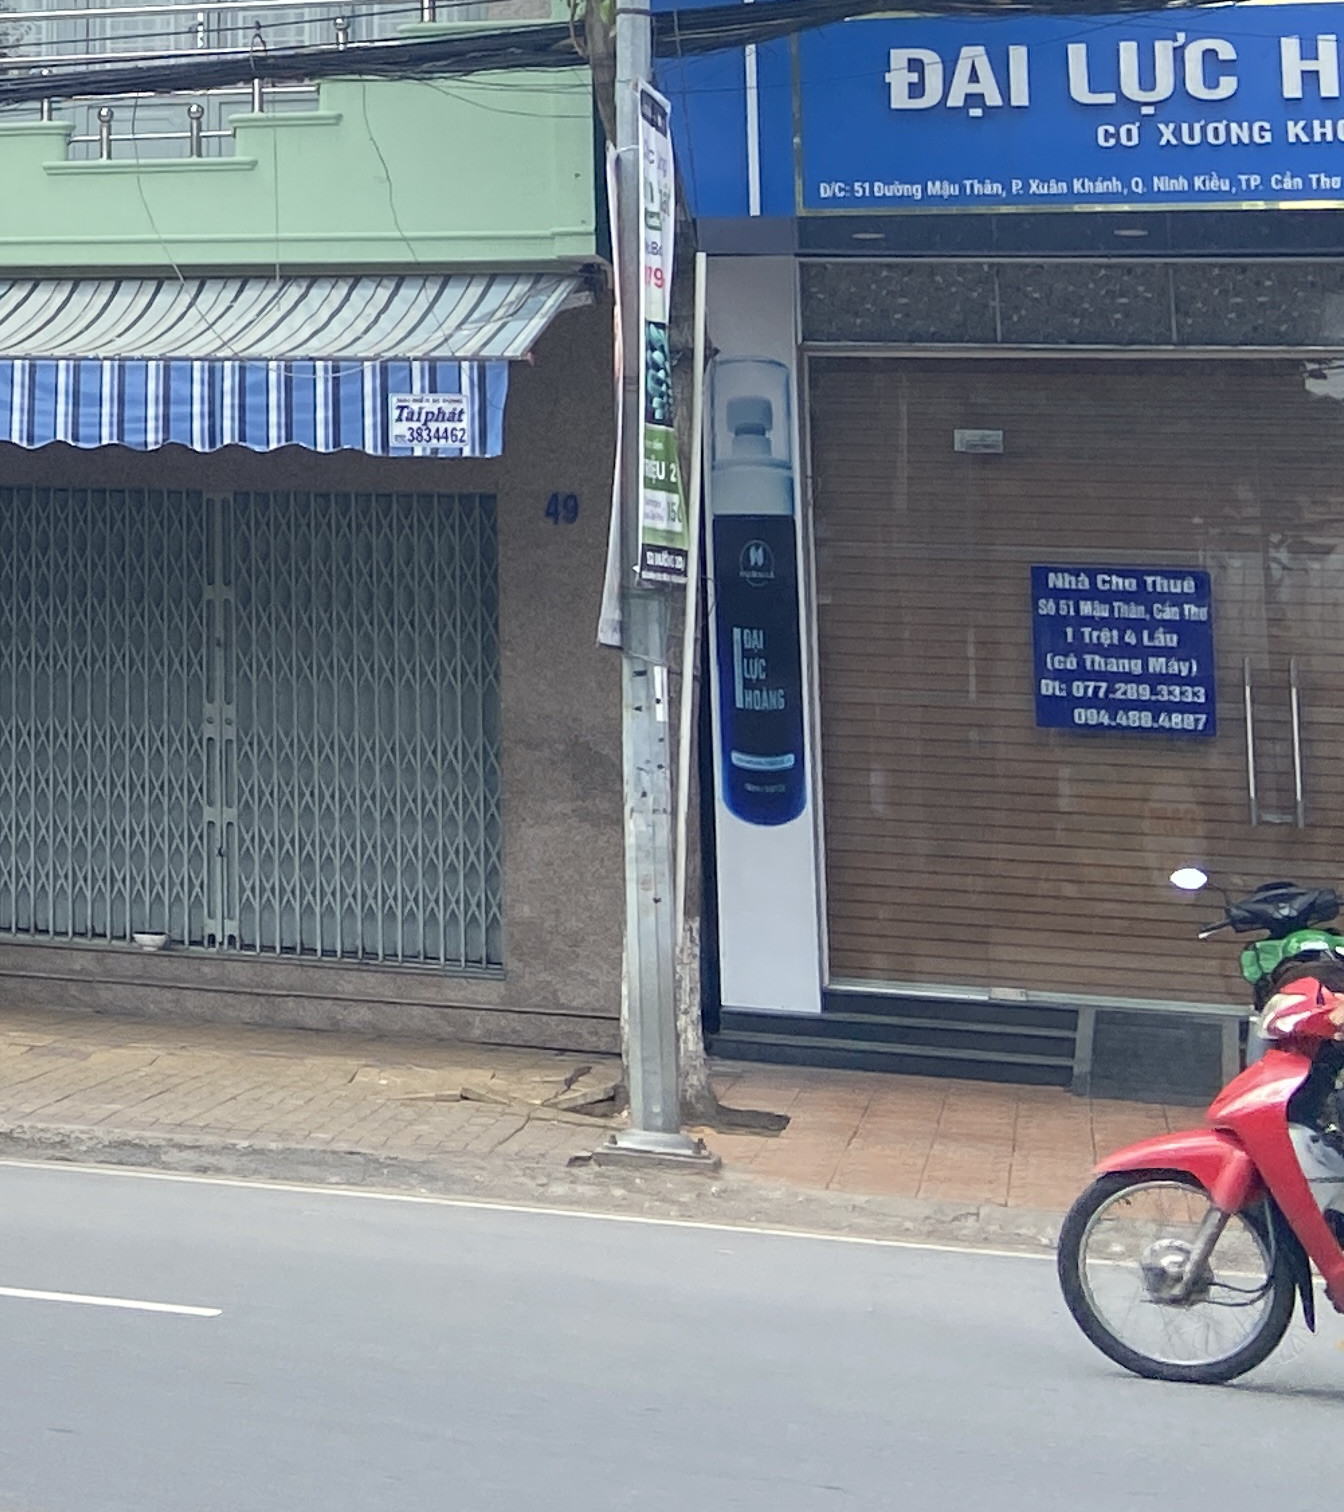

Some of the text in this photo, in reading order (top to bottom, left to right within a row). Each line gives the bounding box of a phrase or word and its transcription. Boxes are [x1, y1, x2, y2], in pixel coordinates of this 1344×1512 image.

[884, 44, 1030, 118] ĐẠI
[1067, 30, 1239, 116] LỰC
[1096, 120, 1143, 148] CƠ
[1157, 118, 1274, 148] XƯƠNG
[853, 181, 870, 197] 51
[873, 180, 922, 200] Đường
[926, 180, 960, 200] Mậu
[1011, 179, 1024, 195] P.
[1028, 178, 1068, 195] Xuân
[1072, 176, 1128, 196] Khánh,
[1131, 176, 1147, 194] Q.
[1238, 174, 1264, 192] TP.
[1270, 170, 1303, 190] Cần
[1307, 172, 1343, 190] Thơ
[407, 426, 466, 444] 3834462
[543, 492, 580, 526] 49
[1047, 571, 1196, 594] Nhà Cho Thuê
[1058, 599, 1075, 616] 51
[1078, 599, 1110, 621] Mậu
[1182, 603, 1209, 622] Thơ
[1065, 626, 1074, 643] 1
[1080, 626, 1119, 648] Trệt
[1124, 628, 1137, 646] 4
[1082, 653, 1143, 676] Thang
[1147, 655, 1199, 678] Máy)
[744, 686, 786, 711] HOÀNG
